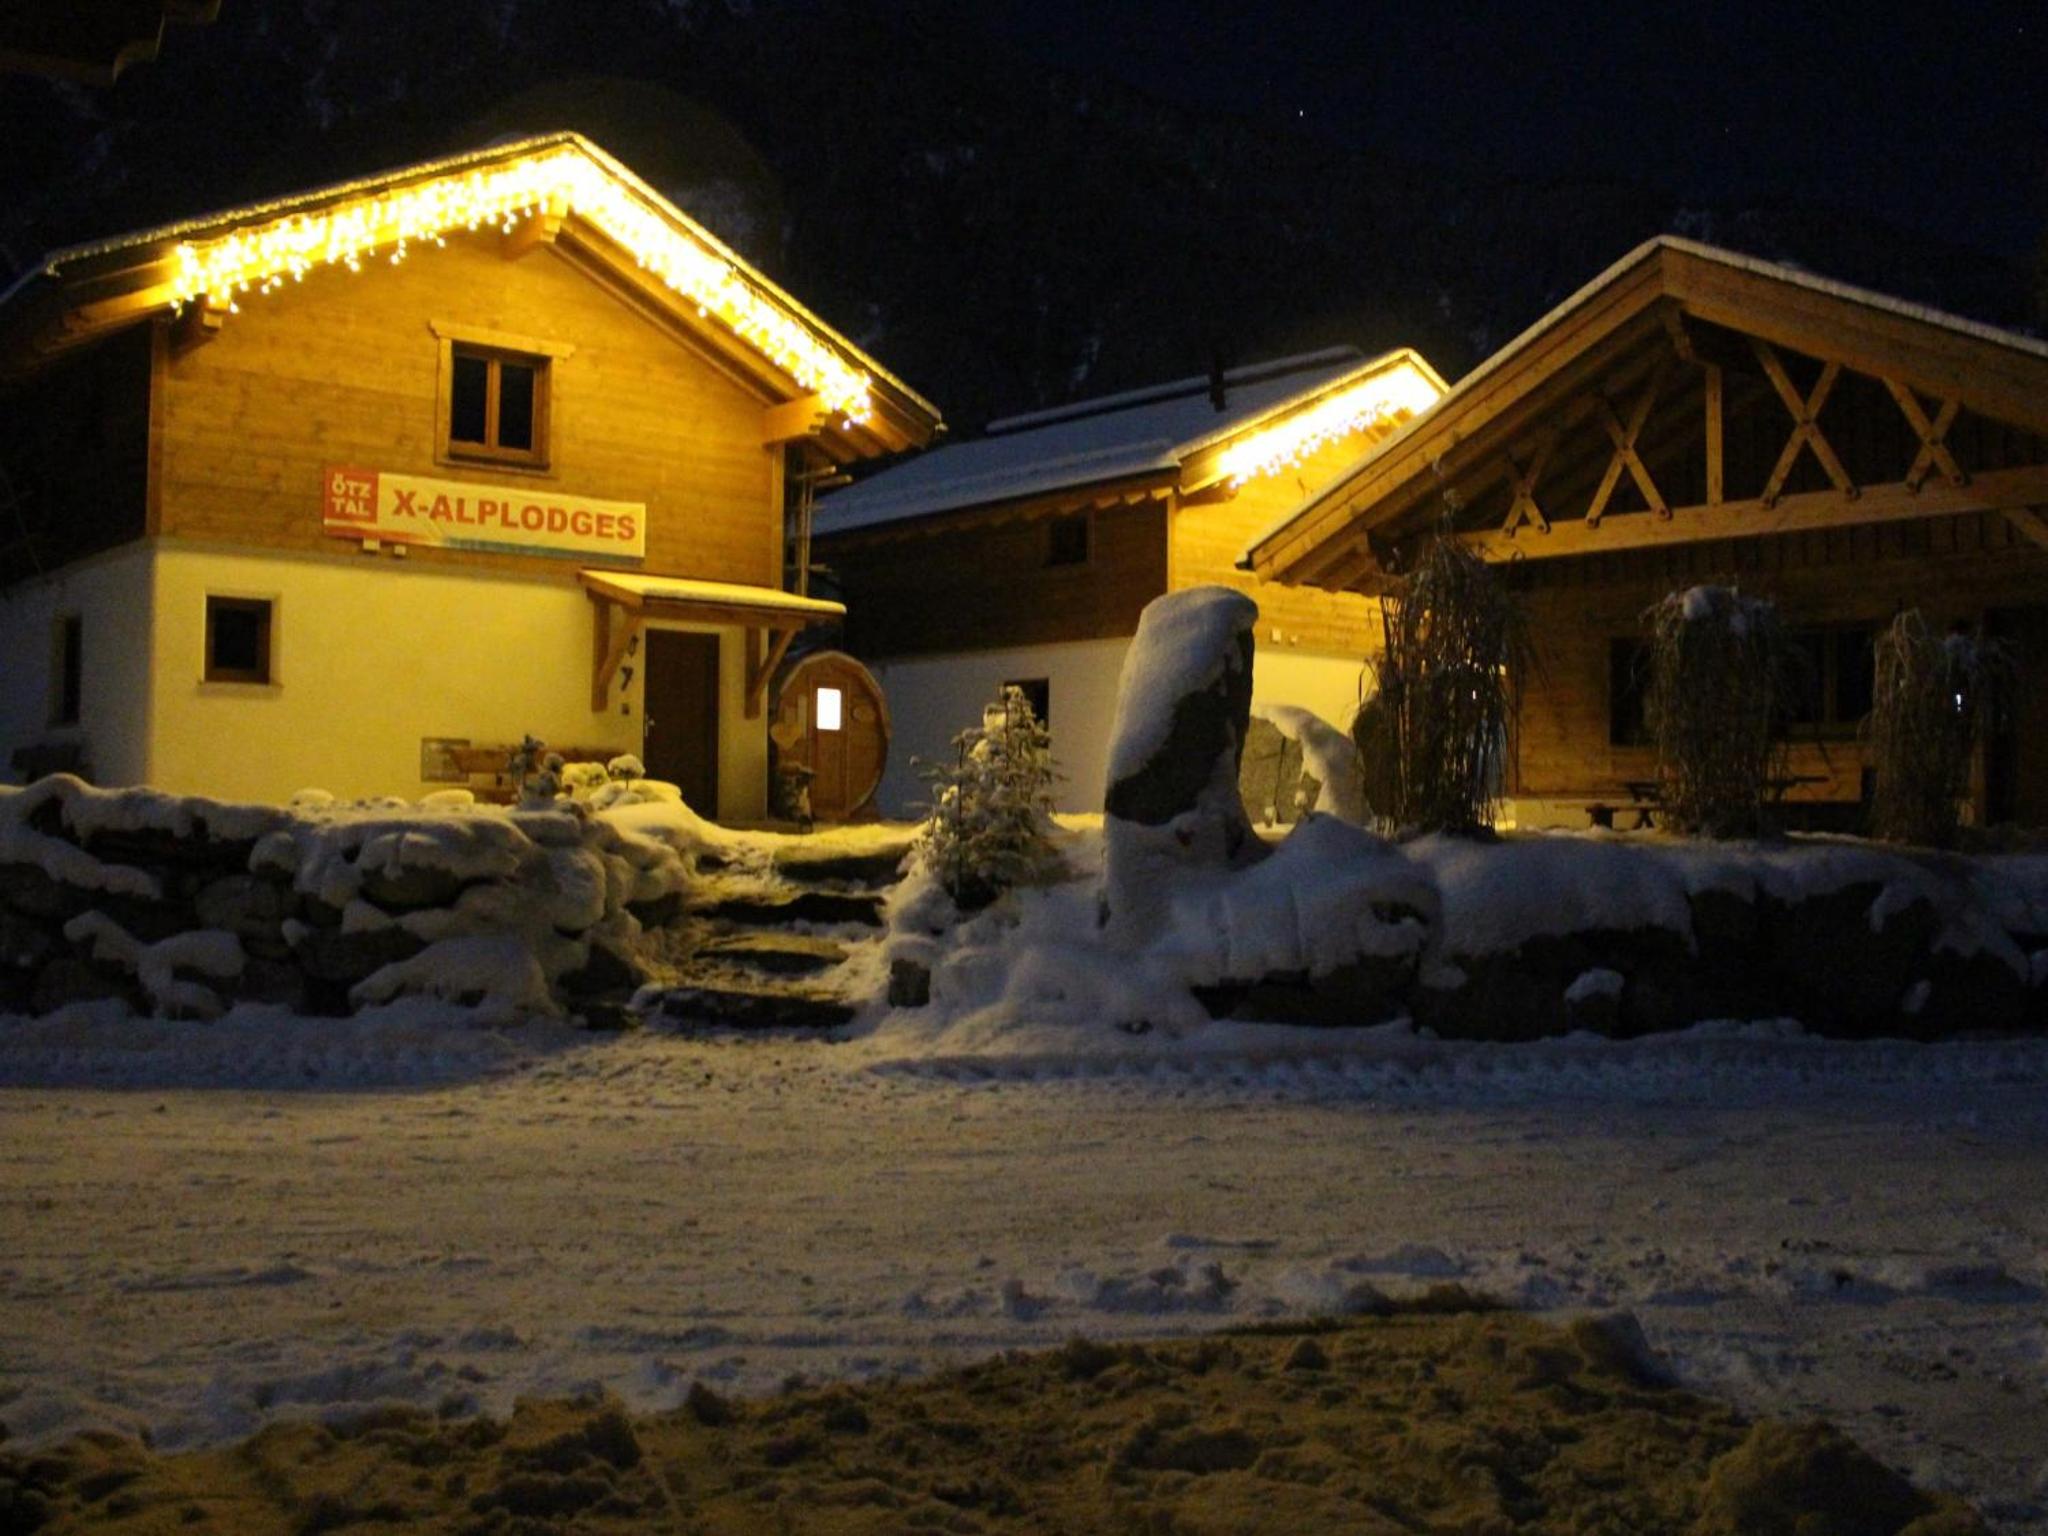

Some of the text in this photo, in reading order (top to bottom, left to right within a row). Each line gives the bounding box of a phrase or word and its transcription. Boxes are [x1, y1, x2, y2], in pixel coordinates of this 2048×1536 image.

[331, 473, 371, 497] ÖTZ
[331, 497, 370, 517] TAL
[392, 489, 637, 542] X-ALPLODGES
